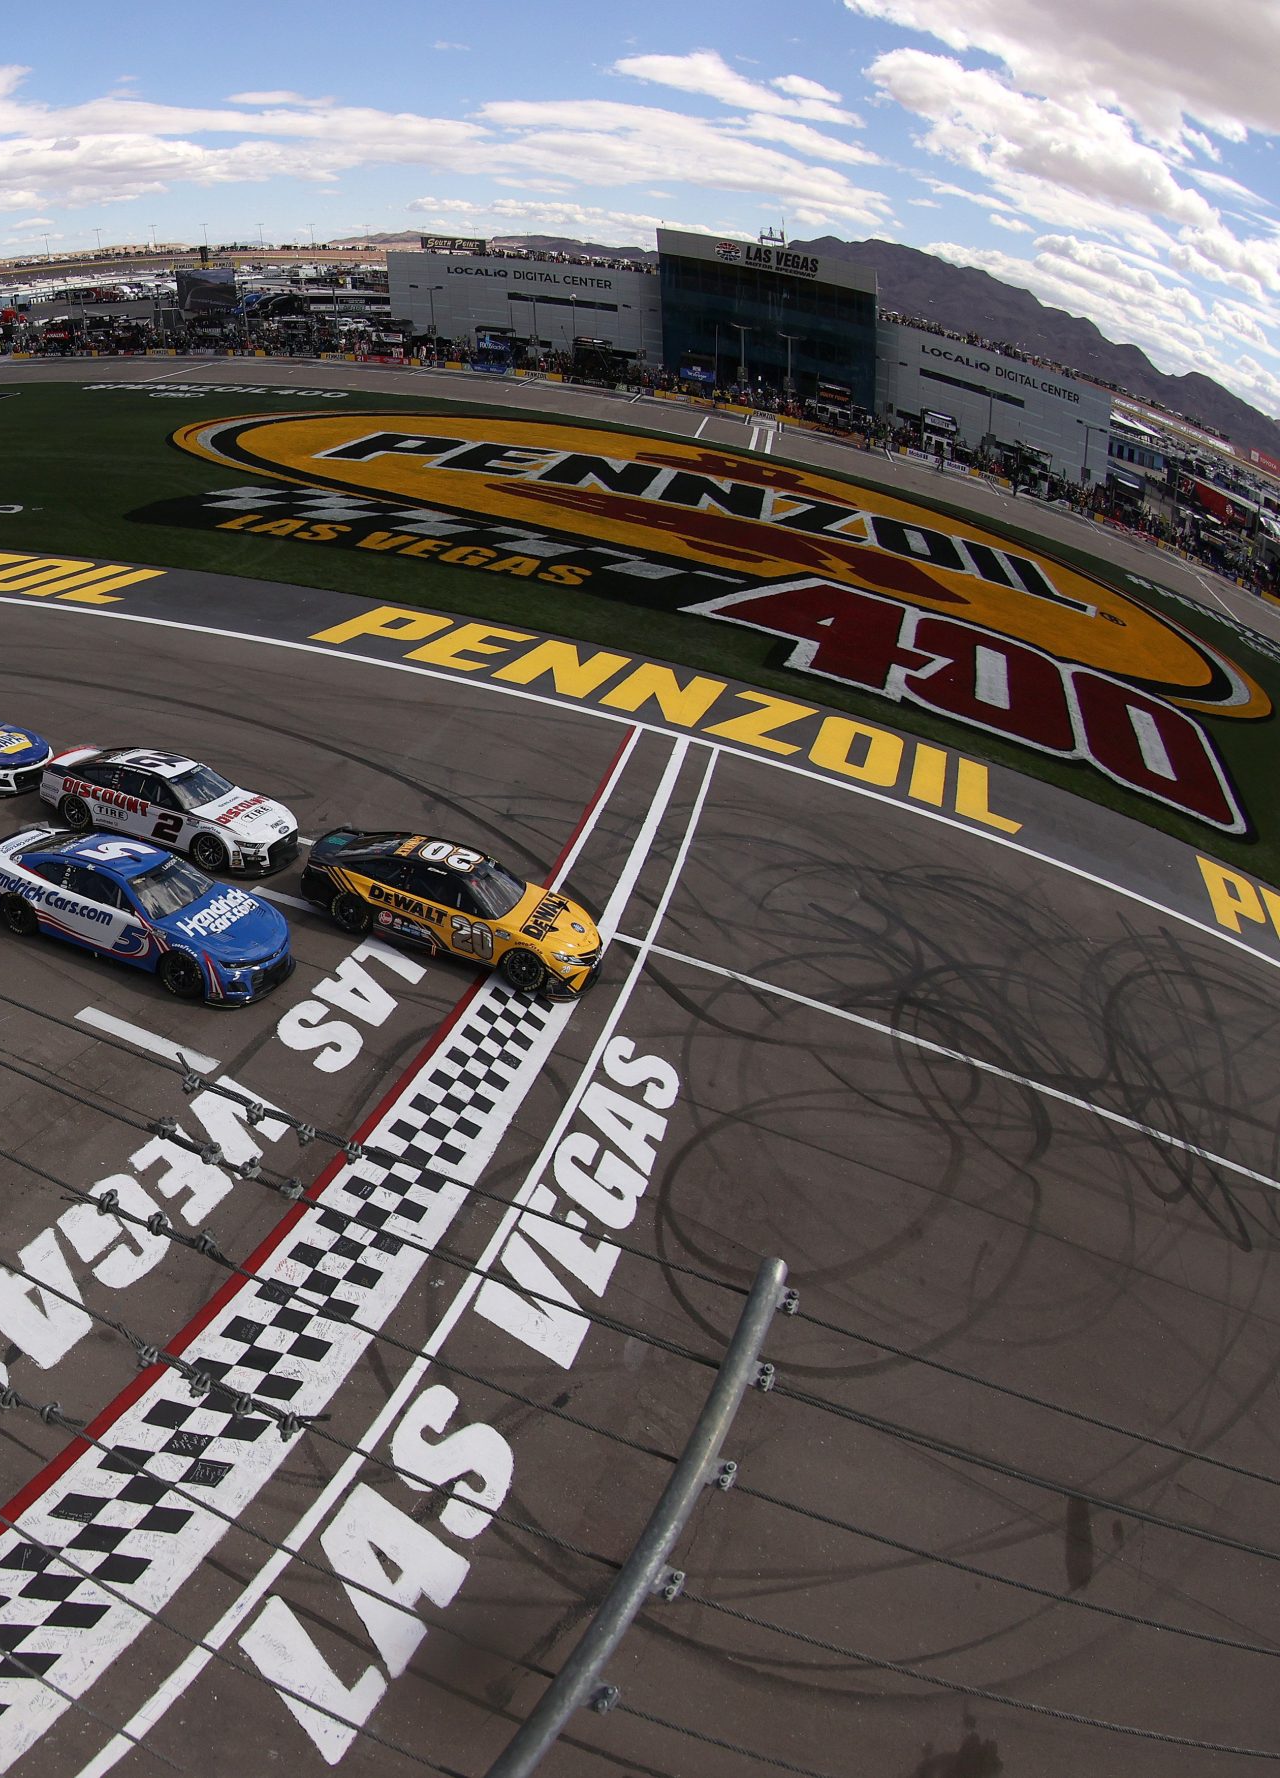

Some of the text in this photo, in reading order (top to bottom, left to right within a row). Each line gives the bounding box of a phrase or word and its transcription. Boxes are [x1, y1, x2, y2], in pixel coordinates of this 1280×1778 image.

[745, 246, 820, 273] LAS VEGAS
[745, 260, 817, 279] MOTOR SPEEDWAY
[447, 266, 612, 290] LOCALiQ DIGITAL CENTER
[921, 344, 1080, 404] LOCALiQ DIGITAL CENTER
[908, 450, 923, 459] Mobil
[946, 461, 961, 470] Mobil
[312, 431, 1097, 618] PENNZOIL
[216, 514, 594, 586] LAS VEGAS
[307, 606, 1023, 834] PENNZOIL
[677, 577, 1247, 836] 400
[61, 776, 152, 817] DISCOUNT
[213, 794, 271, 825] DISCOUNT
[96, 805, 125, 820] TIRE
[244, 805, 269, 820] TIRE
[151, 813, 184, 843] 2
[76, 841, 158, 862] 5
[418, 841, 483, 873] 20
[1195, 855, 1280, 940] P
[176, 888, 250, 938] Hendrick
[111, 924, 148, 953] 5
[171, 943, 198, 958] GOODYEAR
[450, 914, 494, 960] 20
[514, 940, 543, 956] GOODYEAR
[232, 971, 242, 981] 5
[560, 965, 571, 974] 20
[276, 935, 427, 1073] LAS
[239, 1035, 680, 1765] LAS VEGAS
